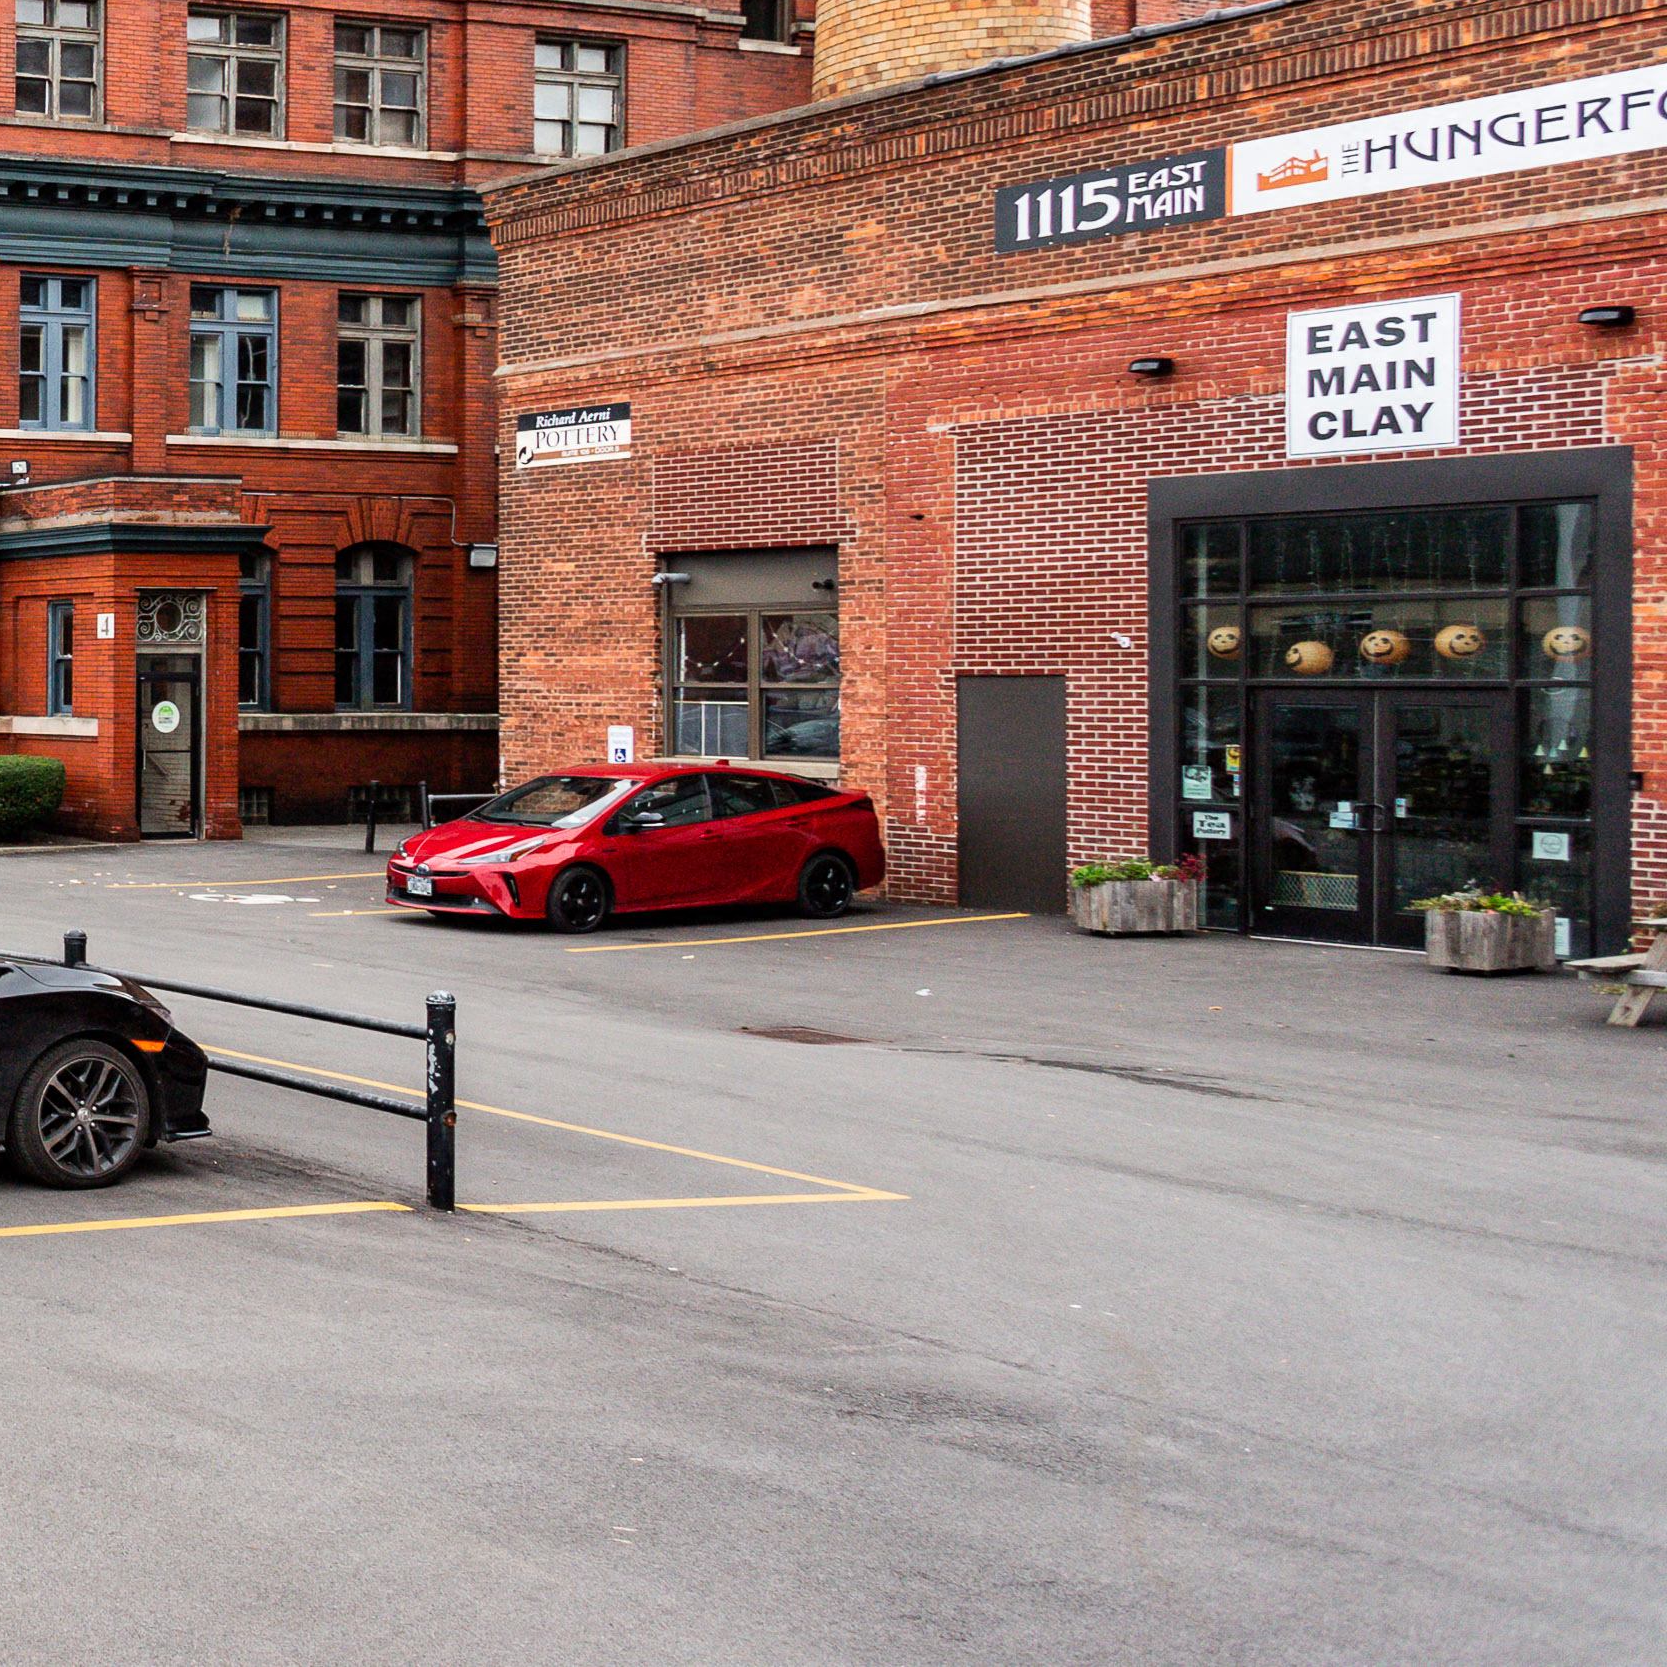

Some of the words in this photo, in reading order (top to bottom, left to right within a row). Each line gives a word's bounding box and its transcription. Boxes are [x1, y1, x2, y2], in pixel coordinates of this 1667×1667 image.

[1341, 141, 1359, 178] THE
[1364, 89, 1667, 174] HUNGERF
[1127, 160, 1208, 194] EAST
[1014, 177, 1121, 241] 1115
[1125, 185, 1205, 224] MAIN
[1307, 312, 1437, 355] EAST
[1307, 357, 1435, 398] MAIN
[535, 411, 576, 428] Richard
[578, 407, 611, 424] Aerni
[535, 424, 621, 449] POTTERY
[1307, 402, 1435, 441] CLAY
[100, 616, 110, 636] 4
[1197, 819, 1226, 829] Tea
